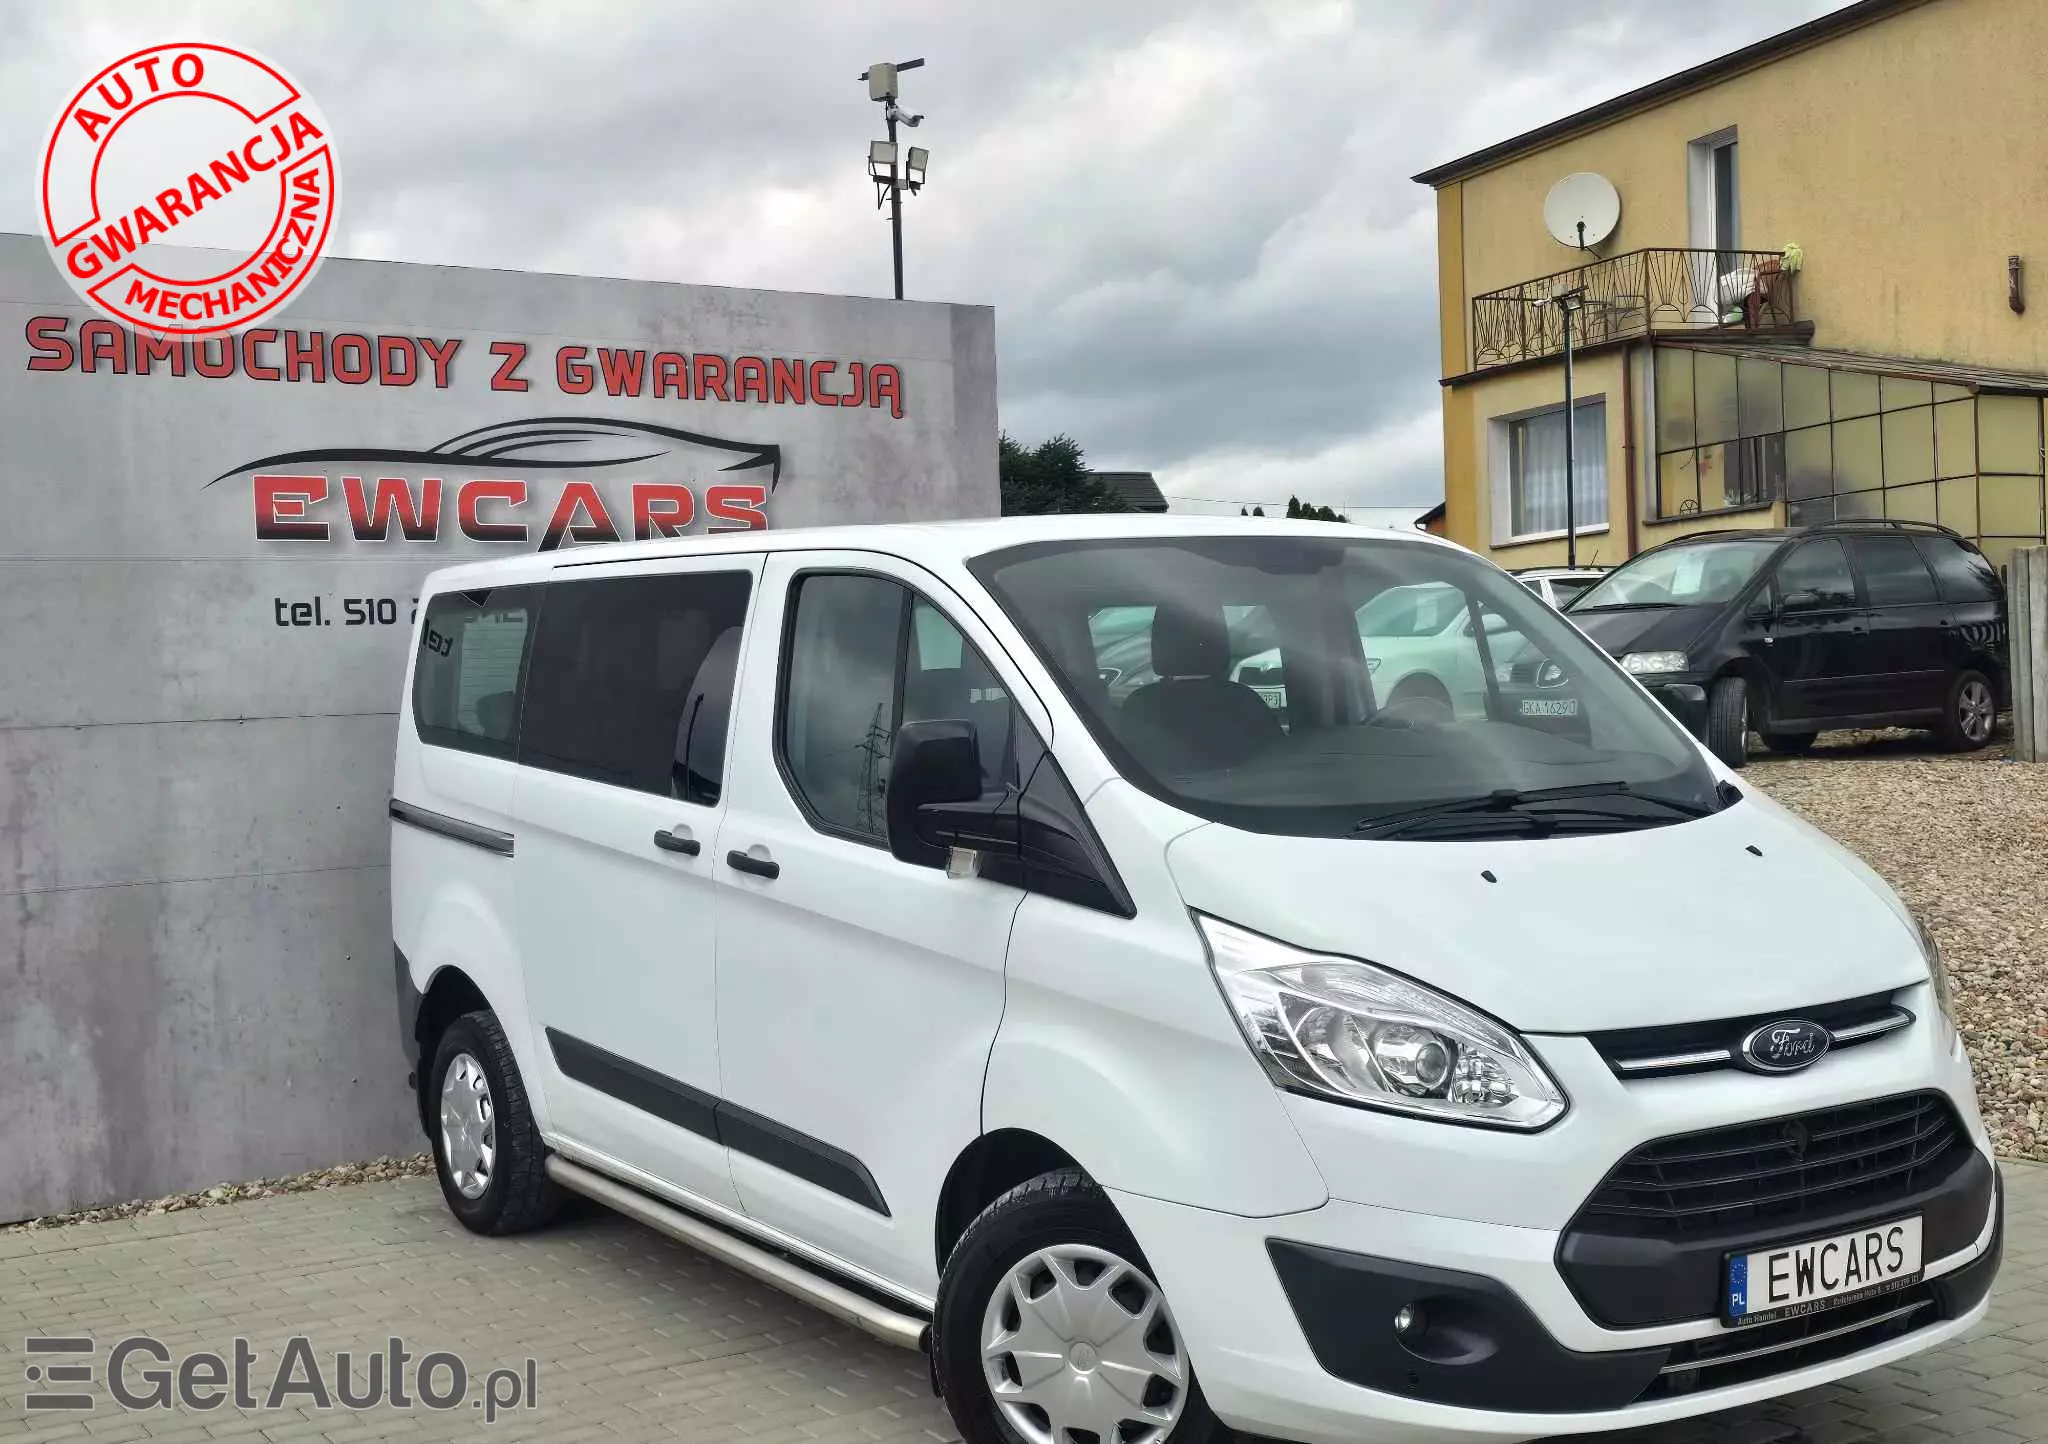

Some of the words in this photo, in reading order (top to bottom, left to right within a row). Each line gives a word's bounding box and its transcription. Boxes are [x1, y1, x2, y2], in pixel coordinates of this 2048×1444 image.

[25, 316, 462, 389] SAMOCHODY
[490, 341, 529, 392] Z
[556, 346, 904, 419] GWARANCJĄ
[252, 474, 769, 553] EWCARS
[275, 597, 331, 627] tel.
[344, 598, 397, 626] 510
[1770, 1028, 1815, 1060] Ford
[1768, 1226, 1904, 1303] EWCARS
[1732, 1292, 1745, 1307] PL
[1784, 1299, 1826, 1317] EWCARS
